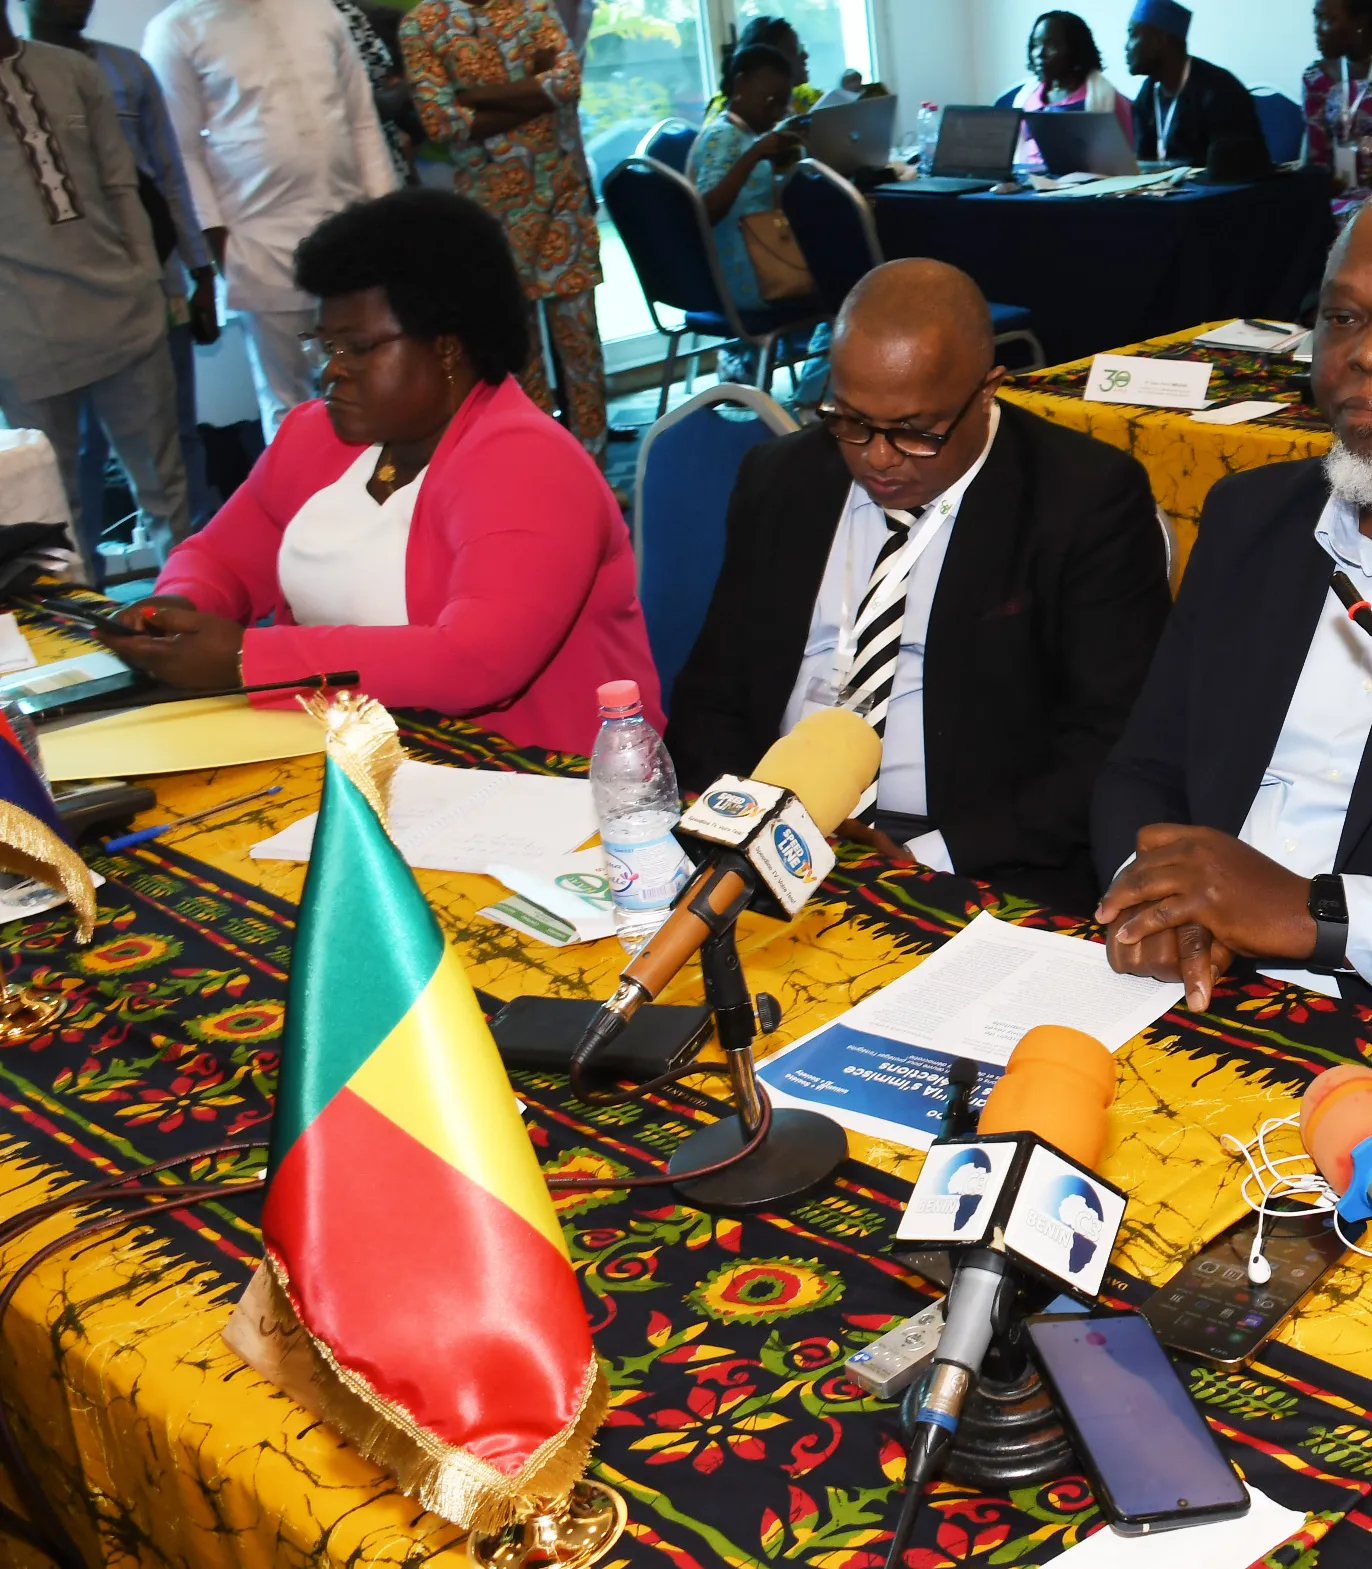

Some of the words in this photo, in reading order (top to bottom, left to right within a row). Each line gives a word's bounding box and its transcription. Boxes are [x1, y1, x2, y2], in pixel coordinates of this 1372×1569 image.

[717, 792, 746, 805] SPEED
[782, 828, 803, 858] SPEED
[777, 839, 800, 869] LINE
[794, 859, 818, 884] TV
[843, 1065, 924, 1091] s'immisce
[878, 1062, 950, 1088] élections
[966, 1170, 988, 1196] C3
[915, 1198, 960, 1215] BENIN
[1025, 1207, 1075, 1249] BENIN
[1074, 1209, 1103, 1243] C3
